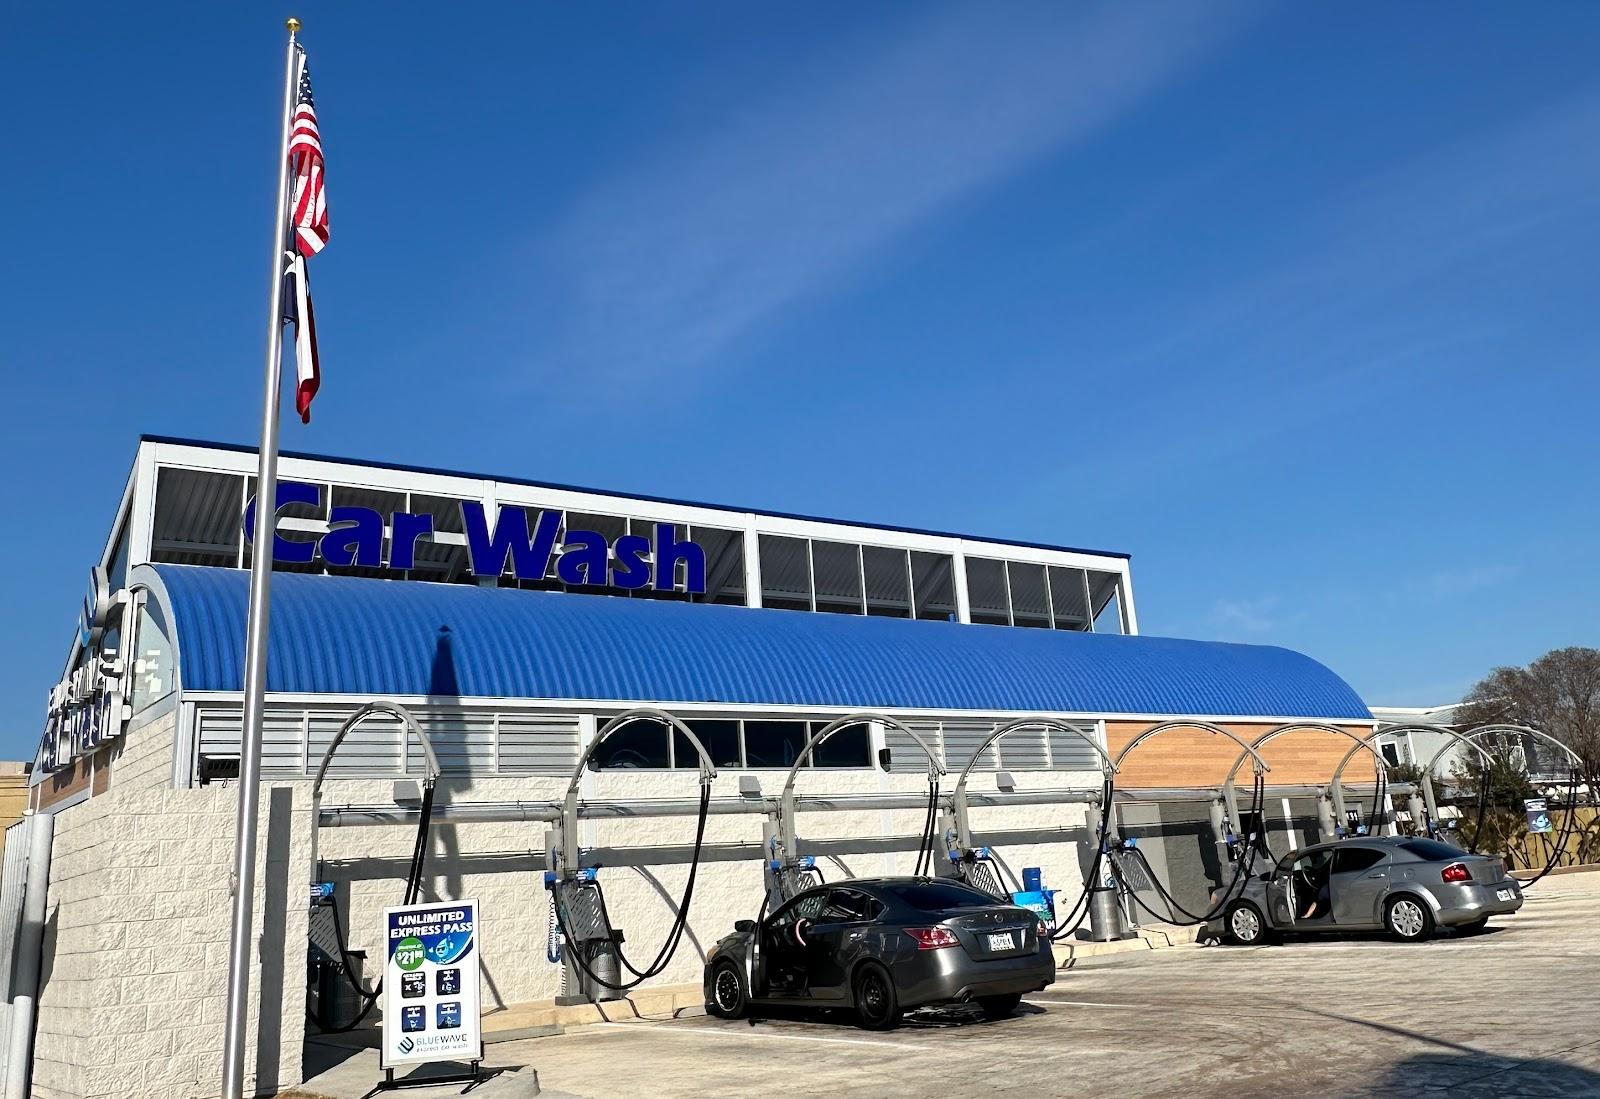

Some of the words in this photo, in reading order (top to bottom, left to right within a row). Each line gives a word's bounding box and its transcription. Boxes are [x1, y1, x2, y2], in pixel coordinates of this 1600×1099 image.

[243, 481, 434, 570] Car
[458, 500, 707, 594] Wash
[398, 910, 465, 926] UNLIMITED
[390, 925, 441, 939] EXPRESS
[443, 922, 473, 934] PASS
